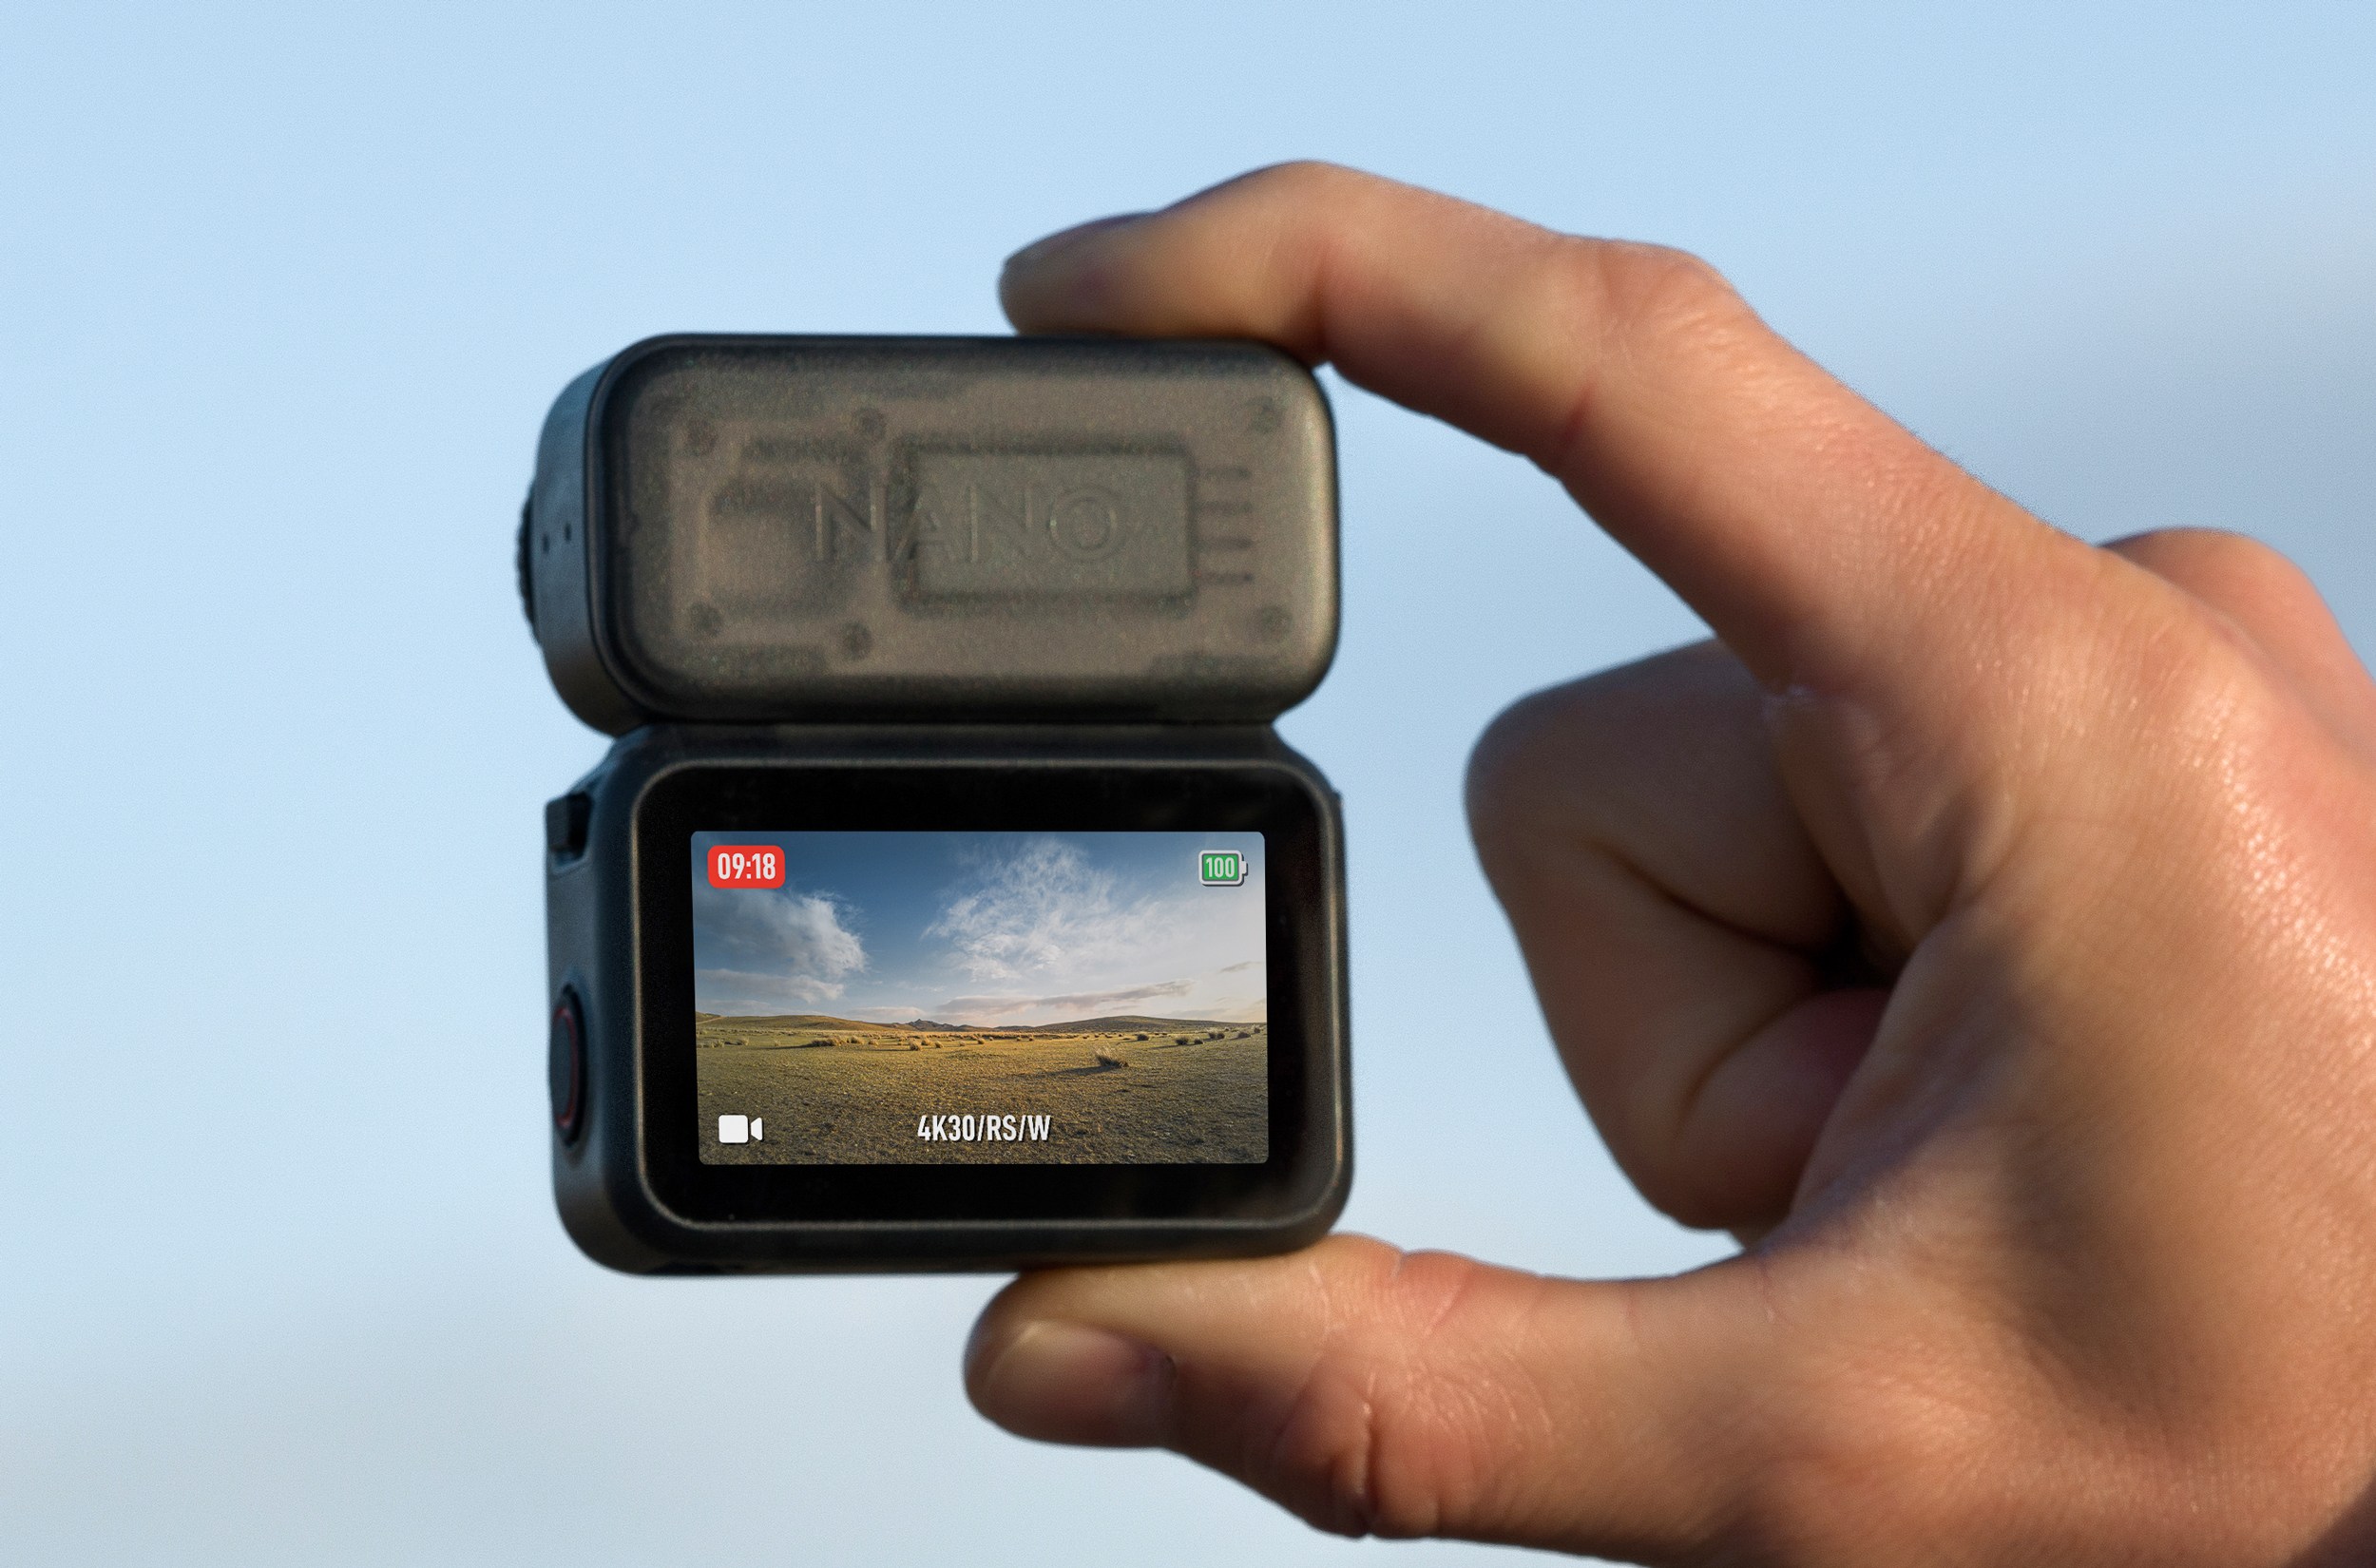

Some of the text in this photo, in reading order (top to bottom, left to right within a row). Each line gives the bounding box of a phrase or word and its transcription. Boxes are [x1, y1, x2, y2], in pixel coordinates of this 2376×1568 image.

[814, 482, 1126, 564] NANO
[717, 852, 776, 880] 09:18
[1205, 857, 1236, 878] 100
[917, 1115, 1051, 1142] 4K30/RS/W
